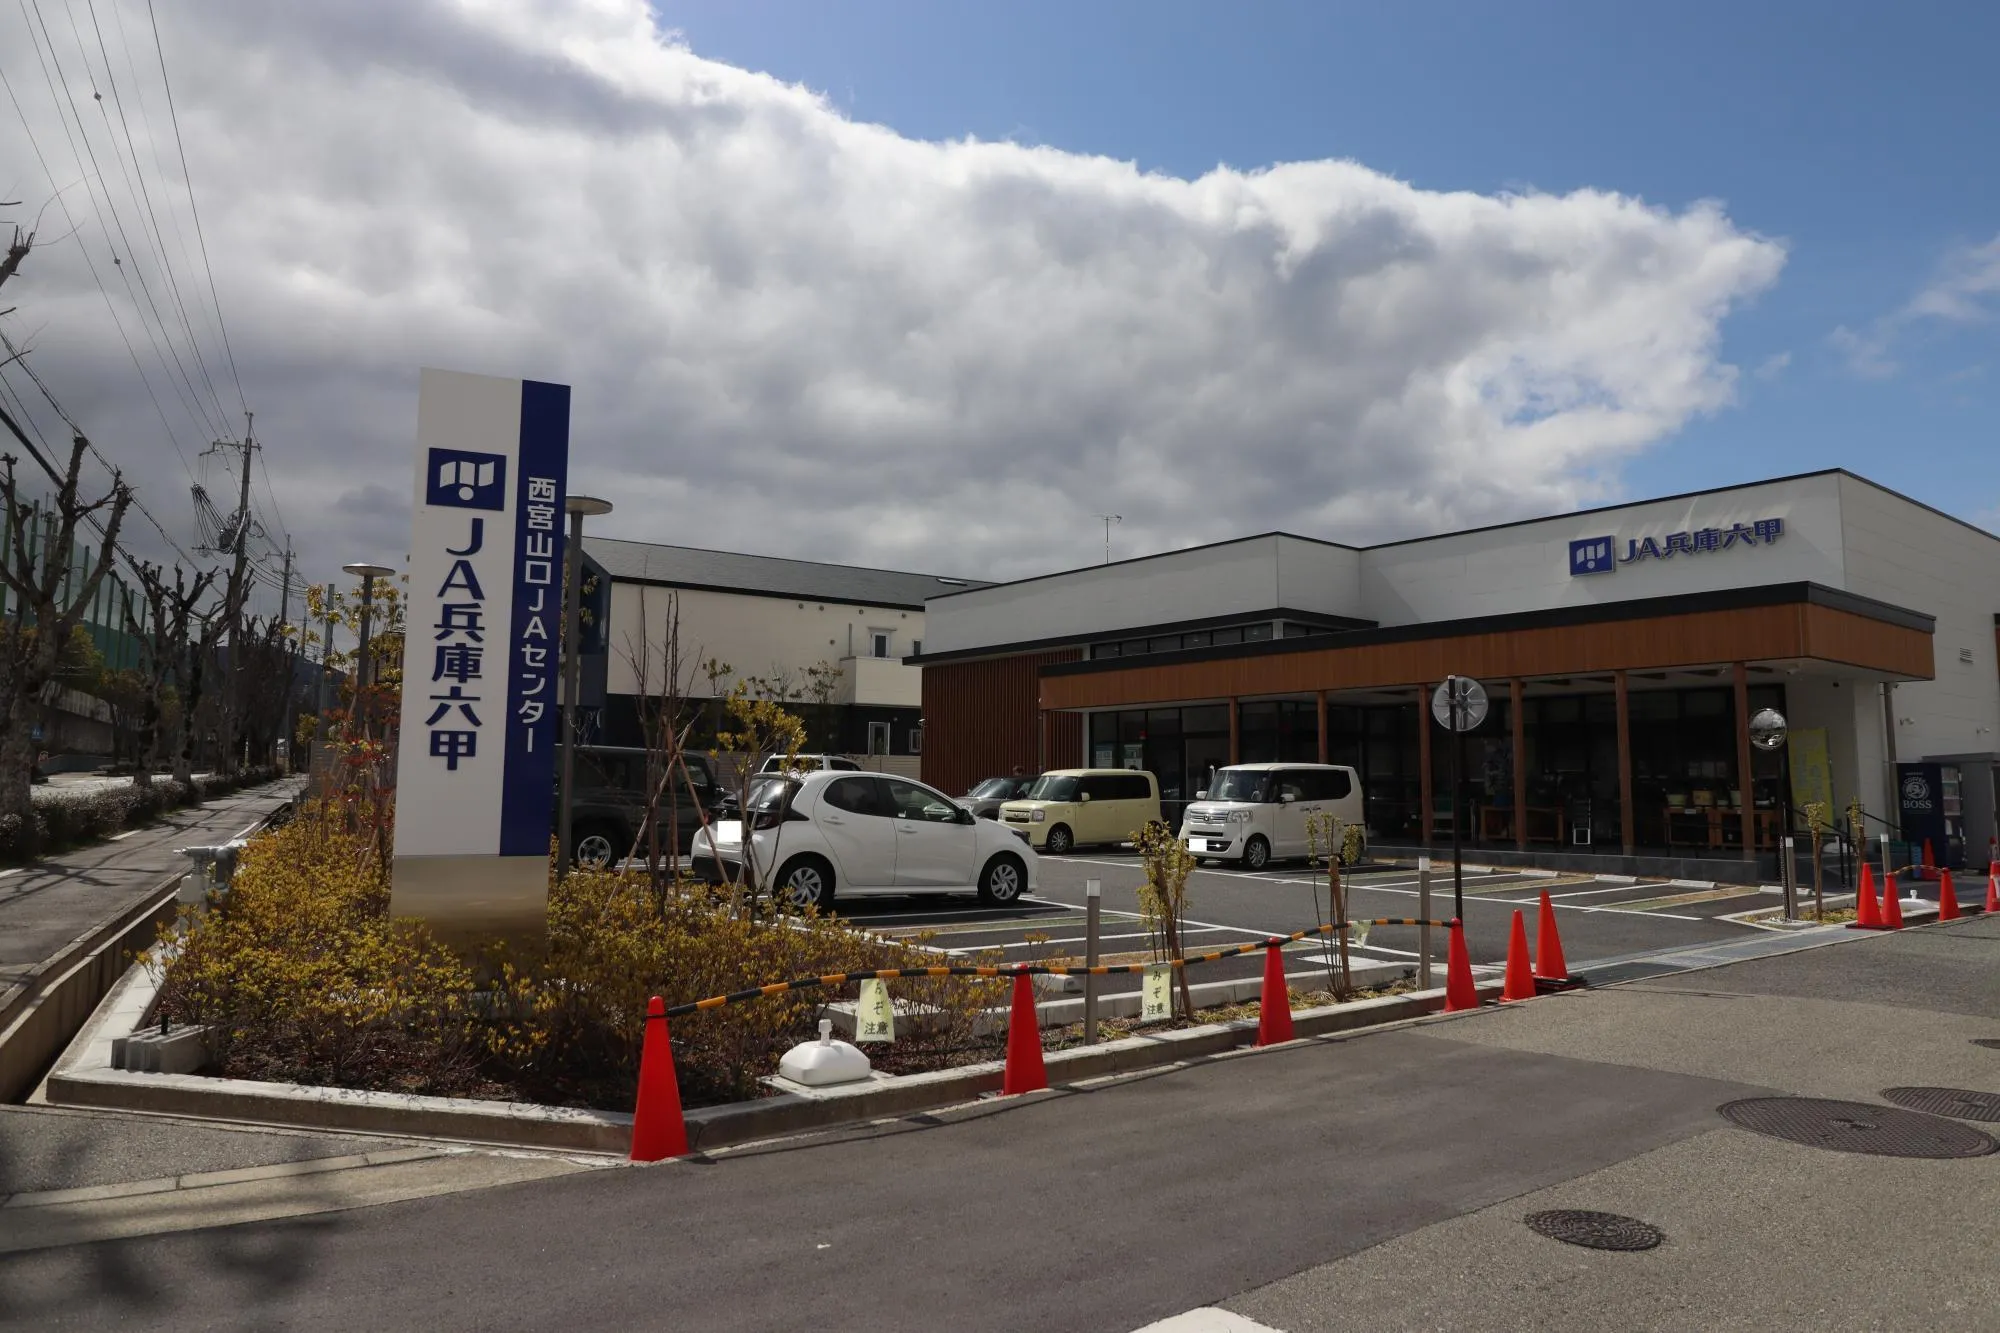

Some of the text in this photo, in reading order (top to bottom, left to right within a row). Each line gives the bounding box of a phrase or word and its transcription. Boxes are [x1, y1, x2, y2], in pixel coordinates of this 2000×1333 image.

[518, 477, 557, 753] 西宮山口JAセンター
[1618, 518, 1785, 564] JA兵庫六甲
[425, 518, 486, 771] JA兵庫六甲
[1903, 799, 1932, 809] BOSS
